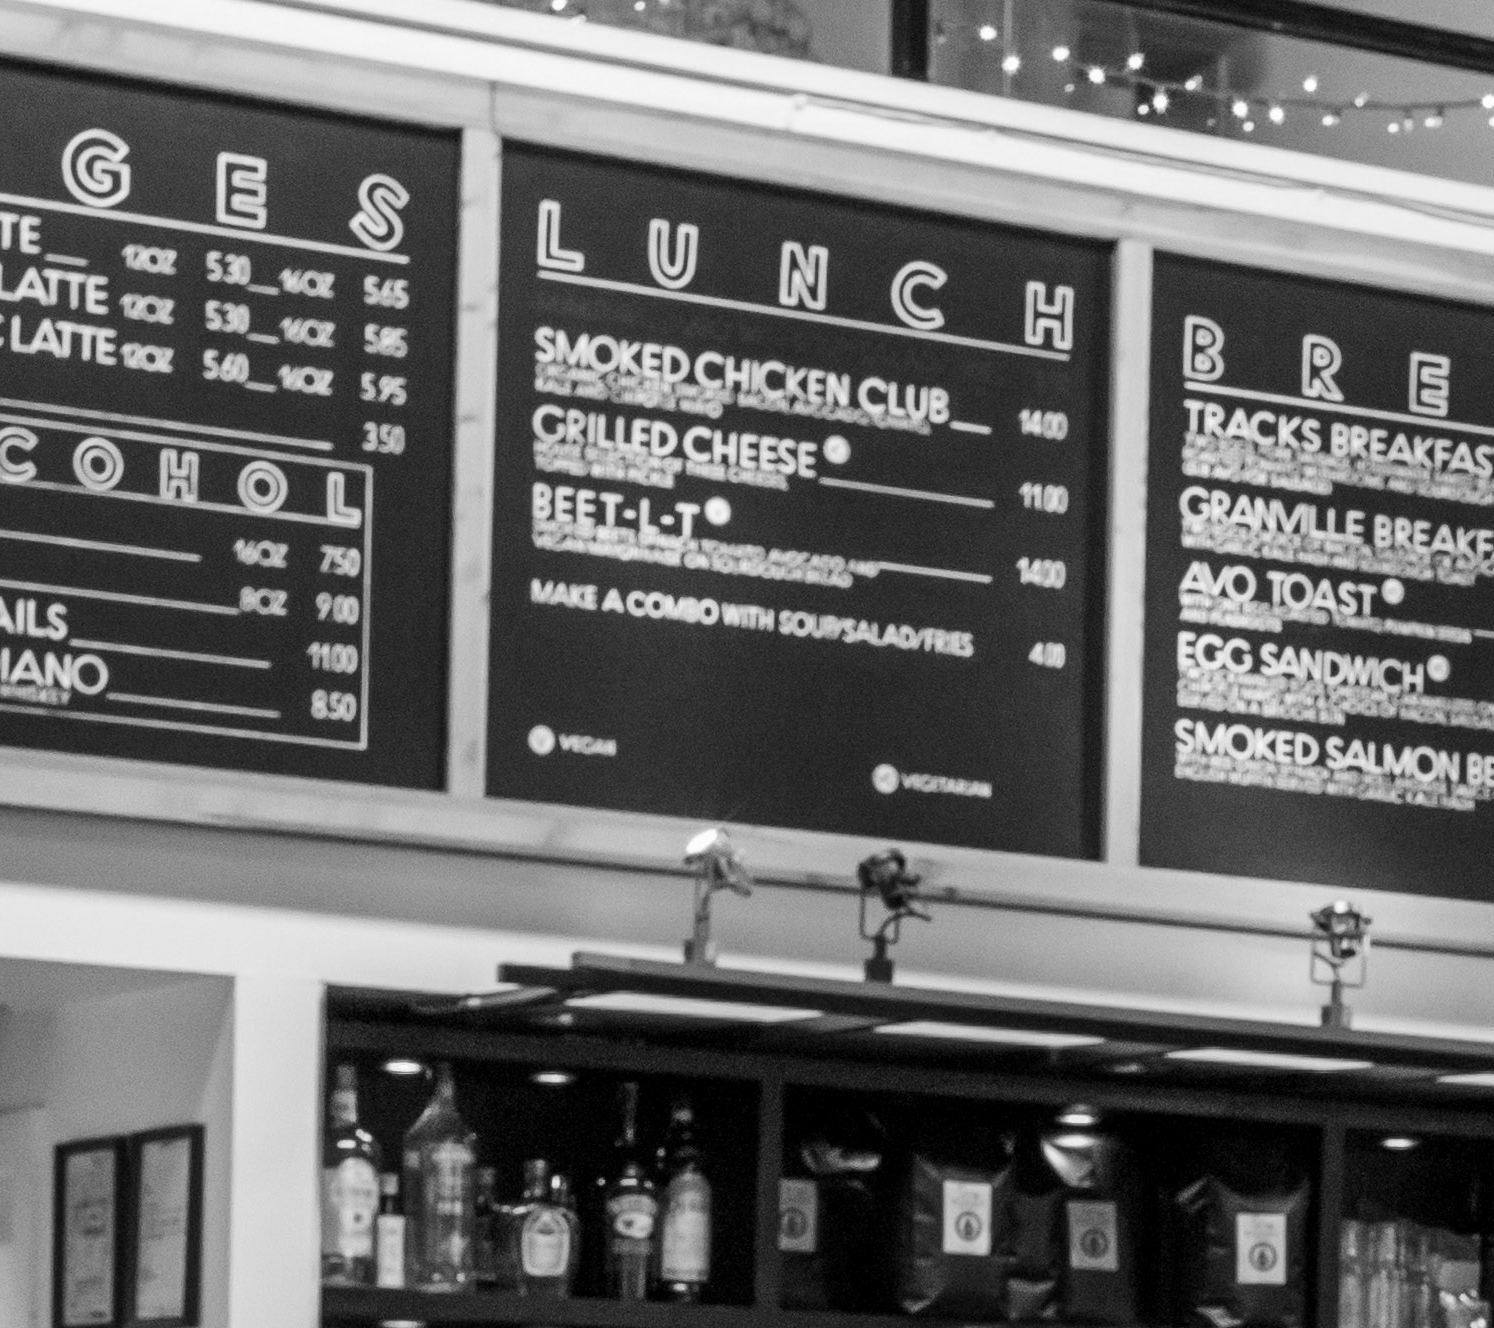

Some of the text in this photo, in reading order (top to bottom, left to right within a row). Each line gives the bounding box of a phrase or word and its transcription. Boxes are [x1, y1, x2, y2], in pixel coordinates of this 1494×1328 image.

[536, 199, 1074, 351] LUNCH
[10, 312, 118, 366] LATTE
[534, 326, 691, 383] SMOKED
[694, 350, 850, 406] CHICKEN
[858, 376, 950, 424] CLUB
[532, 404, 678, 457] GRILLED
[683, 426, 818, 478] CHEESE
[1184, 398, 1321, 452] TRACKS
[1179, 486, 1364, 545] GRANVILLE
[531, 578, 598, 611] MAKE
[601, 587, 625, 614] A
[626, 590, 720, 626] COMBO
[721, 602, 774, 632] WITH
[1179, 561, 1256, 601] AVO
[1267, 570, 1377, 618] TOAST
[1177, 631, 1253, 675] EGG
[1260, 642, 1423, 694] SANDWICH
[1174, 719, 1319, 766] SMOKED
[1325, 737, 1459, 783] SALMON
